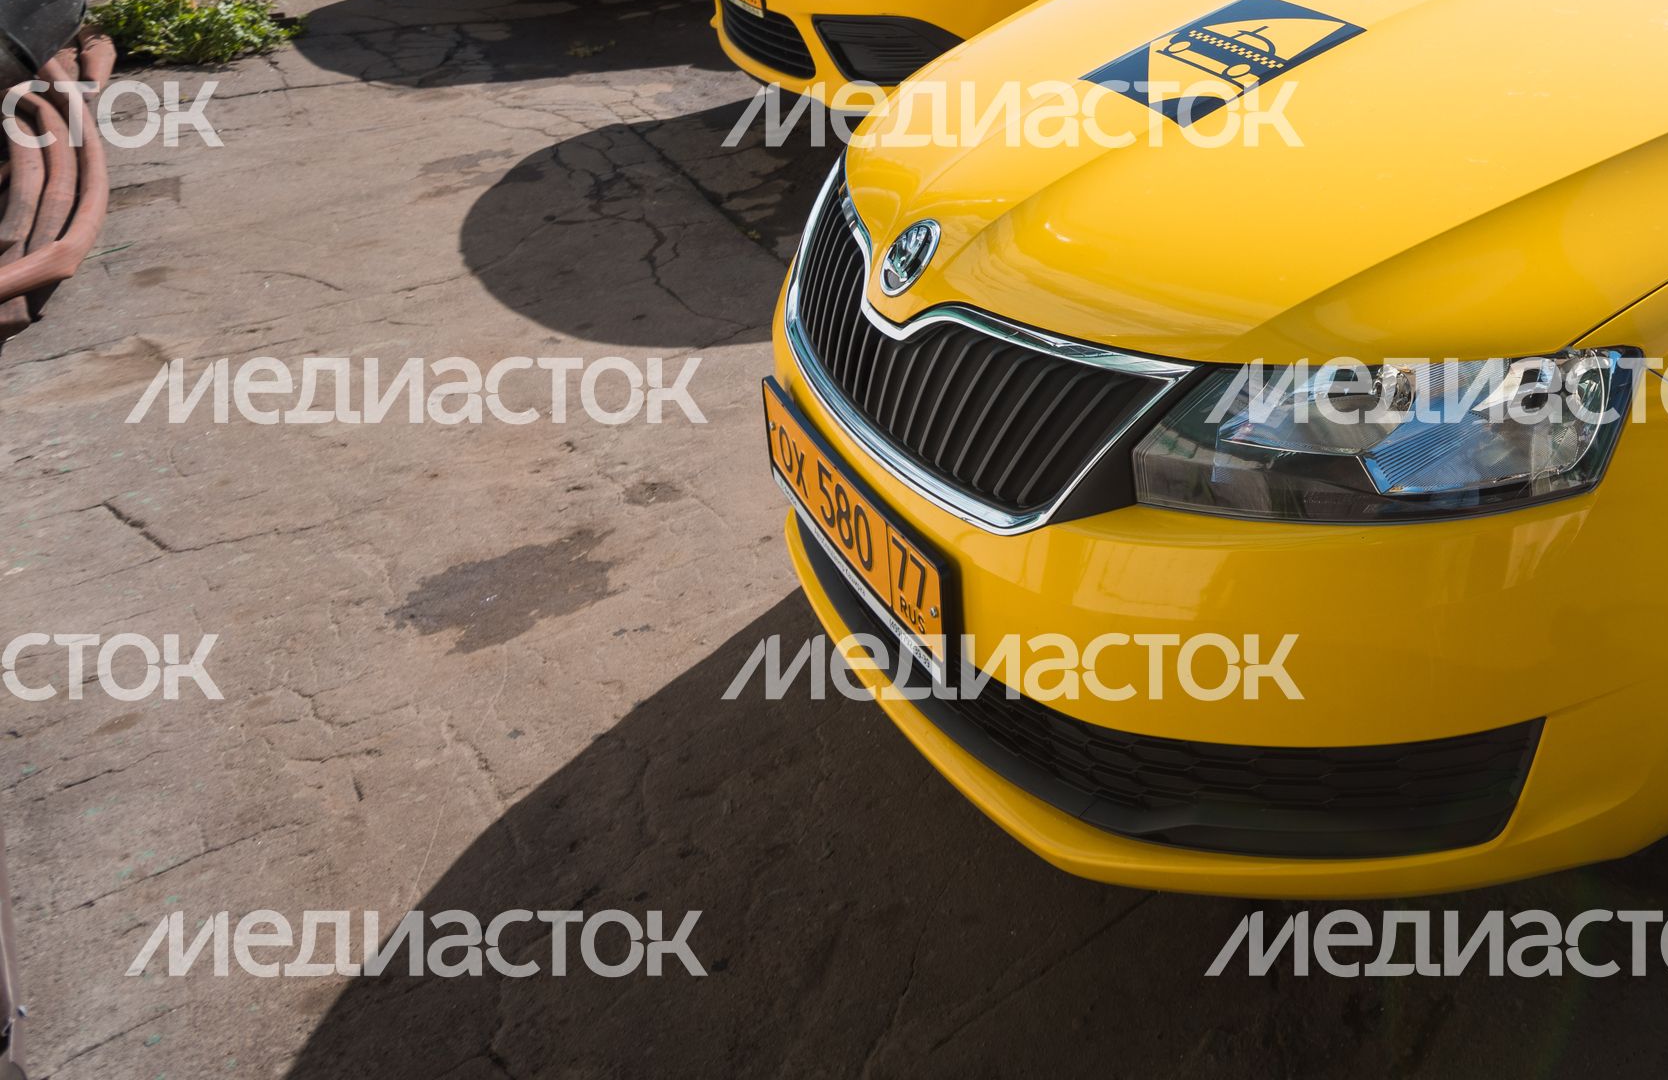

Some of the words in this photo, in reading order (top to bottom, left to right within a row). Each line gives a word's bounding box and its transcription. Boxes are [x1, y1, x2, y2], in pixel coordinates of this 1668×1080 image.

[817, 458, 873, 571] 580
[892, 537, 926, 610] 77
[900, 596, 925, 634] RUS
